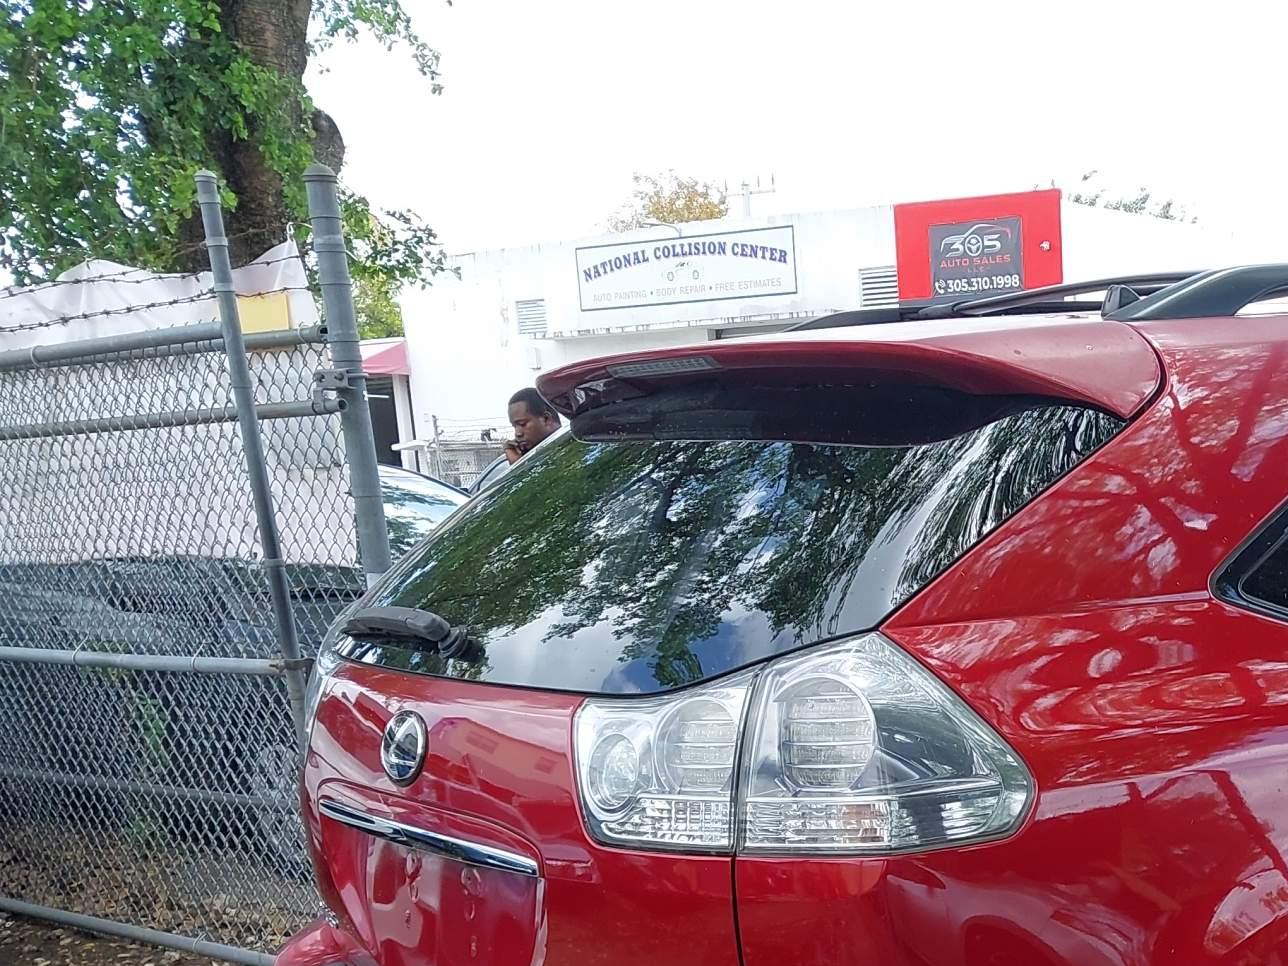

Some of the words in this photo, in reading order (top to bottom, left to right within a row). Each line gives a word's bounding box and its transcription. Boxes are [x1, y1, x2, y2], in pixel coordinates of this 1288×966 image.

[583, 249, 650, 283] NATIONAL
[653, 241, 728, 260] COLLISION
[730, 242, 788, 265] CENTER
[940, 258, 970, 268] AUTO
[973, 255, 1010, 265] SALES
[593, 293, 612, 303] AUTO
[613, 289, 648, 301] PAINTING
[655, 287, 677, 297] BODY
[679, 284, 706, 295] REPAIR
[715, 282, 735, 292] FREE
[738, 277, 783, 290] ESTIMATES
[947, 274, 1019, 292] 305.310.1998
